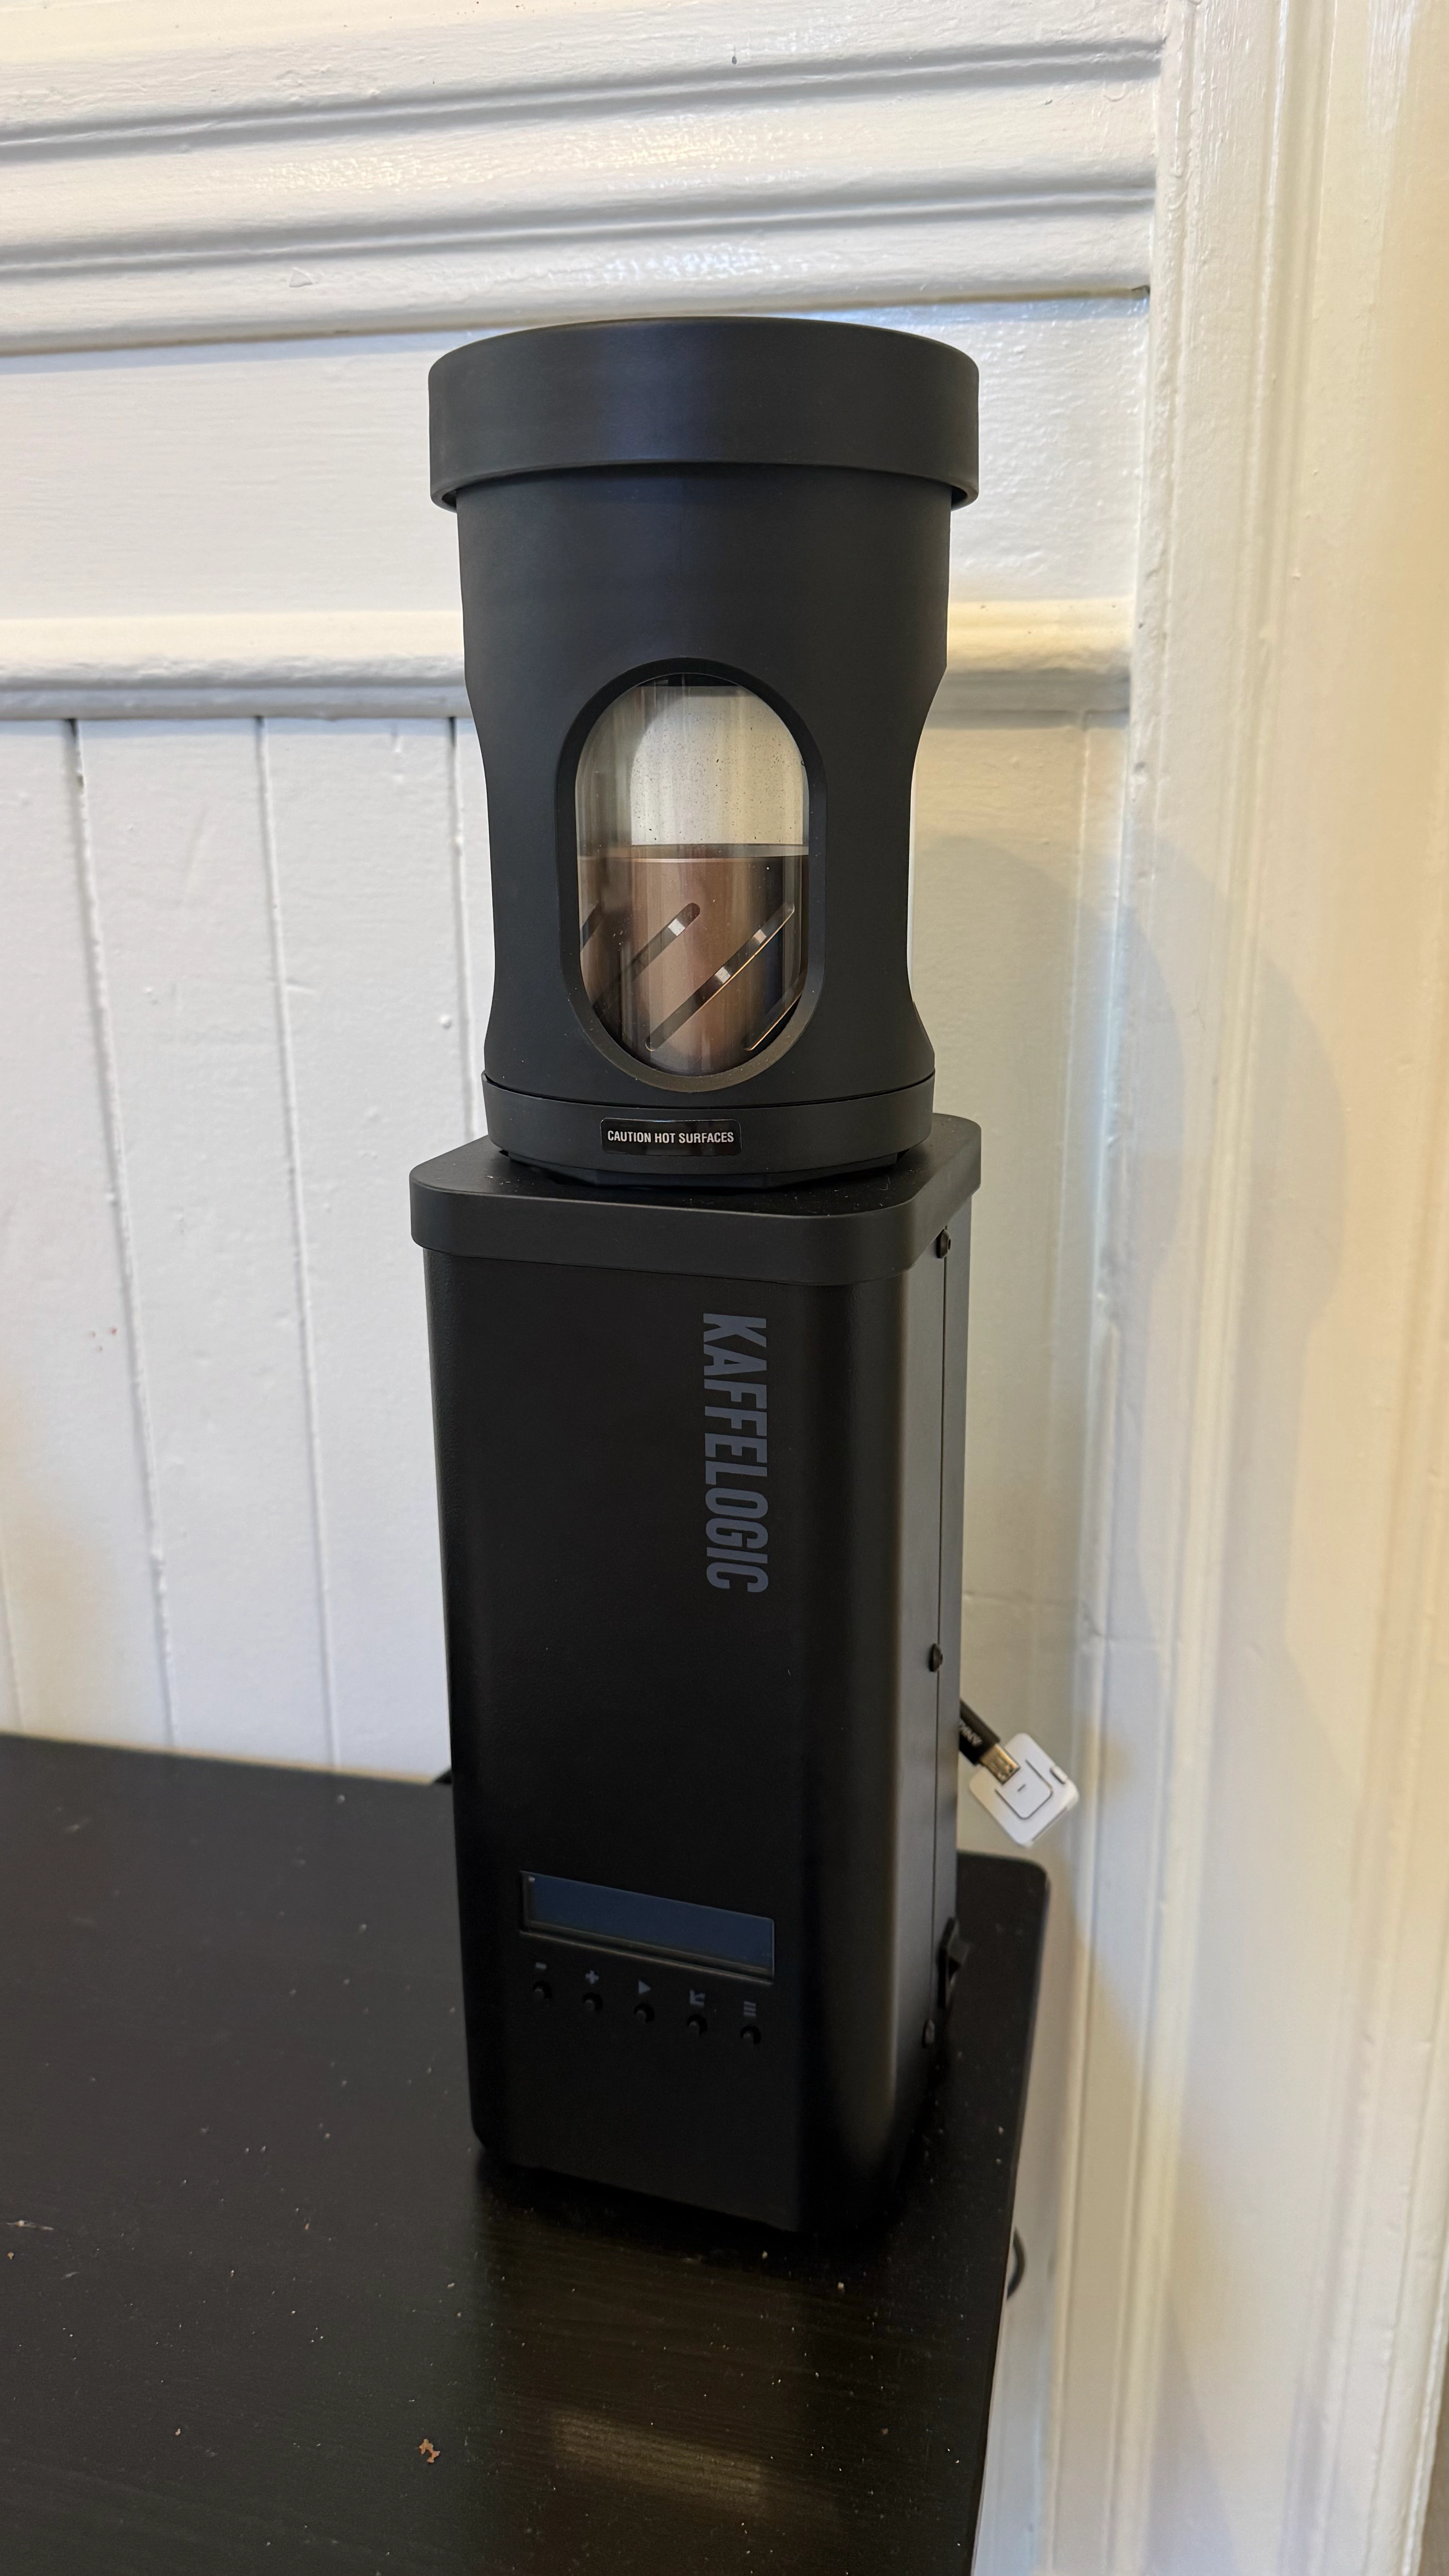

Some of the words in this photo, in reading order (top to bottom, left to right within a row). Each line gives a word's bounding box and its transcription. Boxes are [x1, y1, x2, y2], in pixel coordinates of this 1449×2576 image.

[607, 1130, 651, 1143] CAUTION
[654, 1132, 676, 1143] HOT
[679, 1132, 734, 1144] SURFACES
[703, 1313, 768, 1593] KAFFELOGIC
